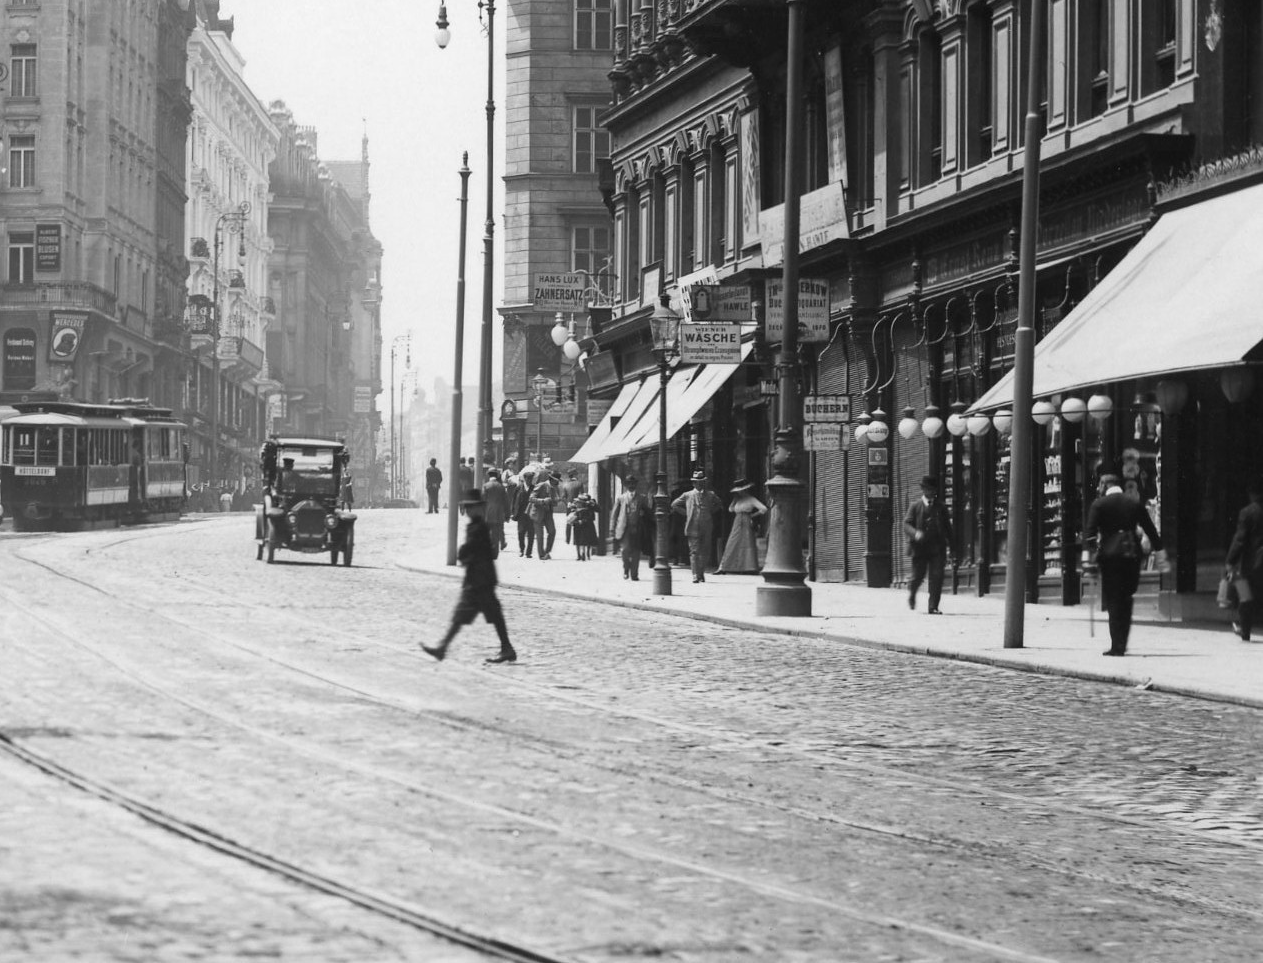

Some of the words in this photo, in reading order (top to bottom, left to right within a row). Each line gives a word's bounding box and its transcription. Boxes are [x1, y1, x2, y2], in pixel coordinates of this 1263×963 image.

[538, 275, 562, 283] HANS
[535, 288, 583, 300] ZAHNERSATZ
[723, 301, 749, 311] HAWLE
